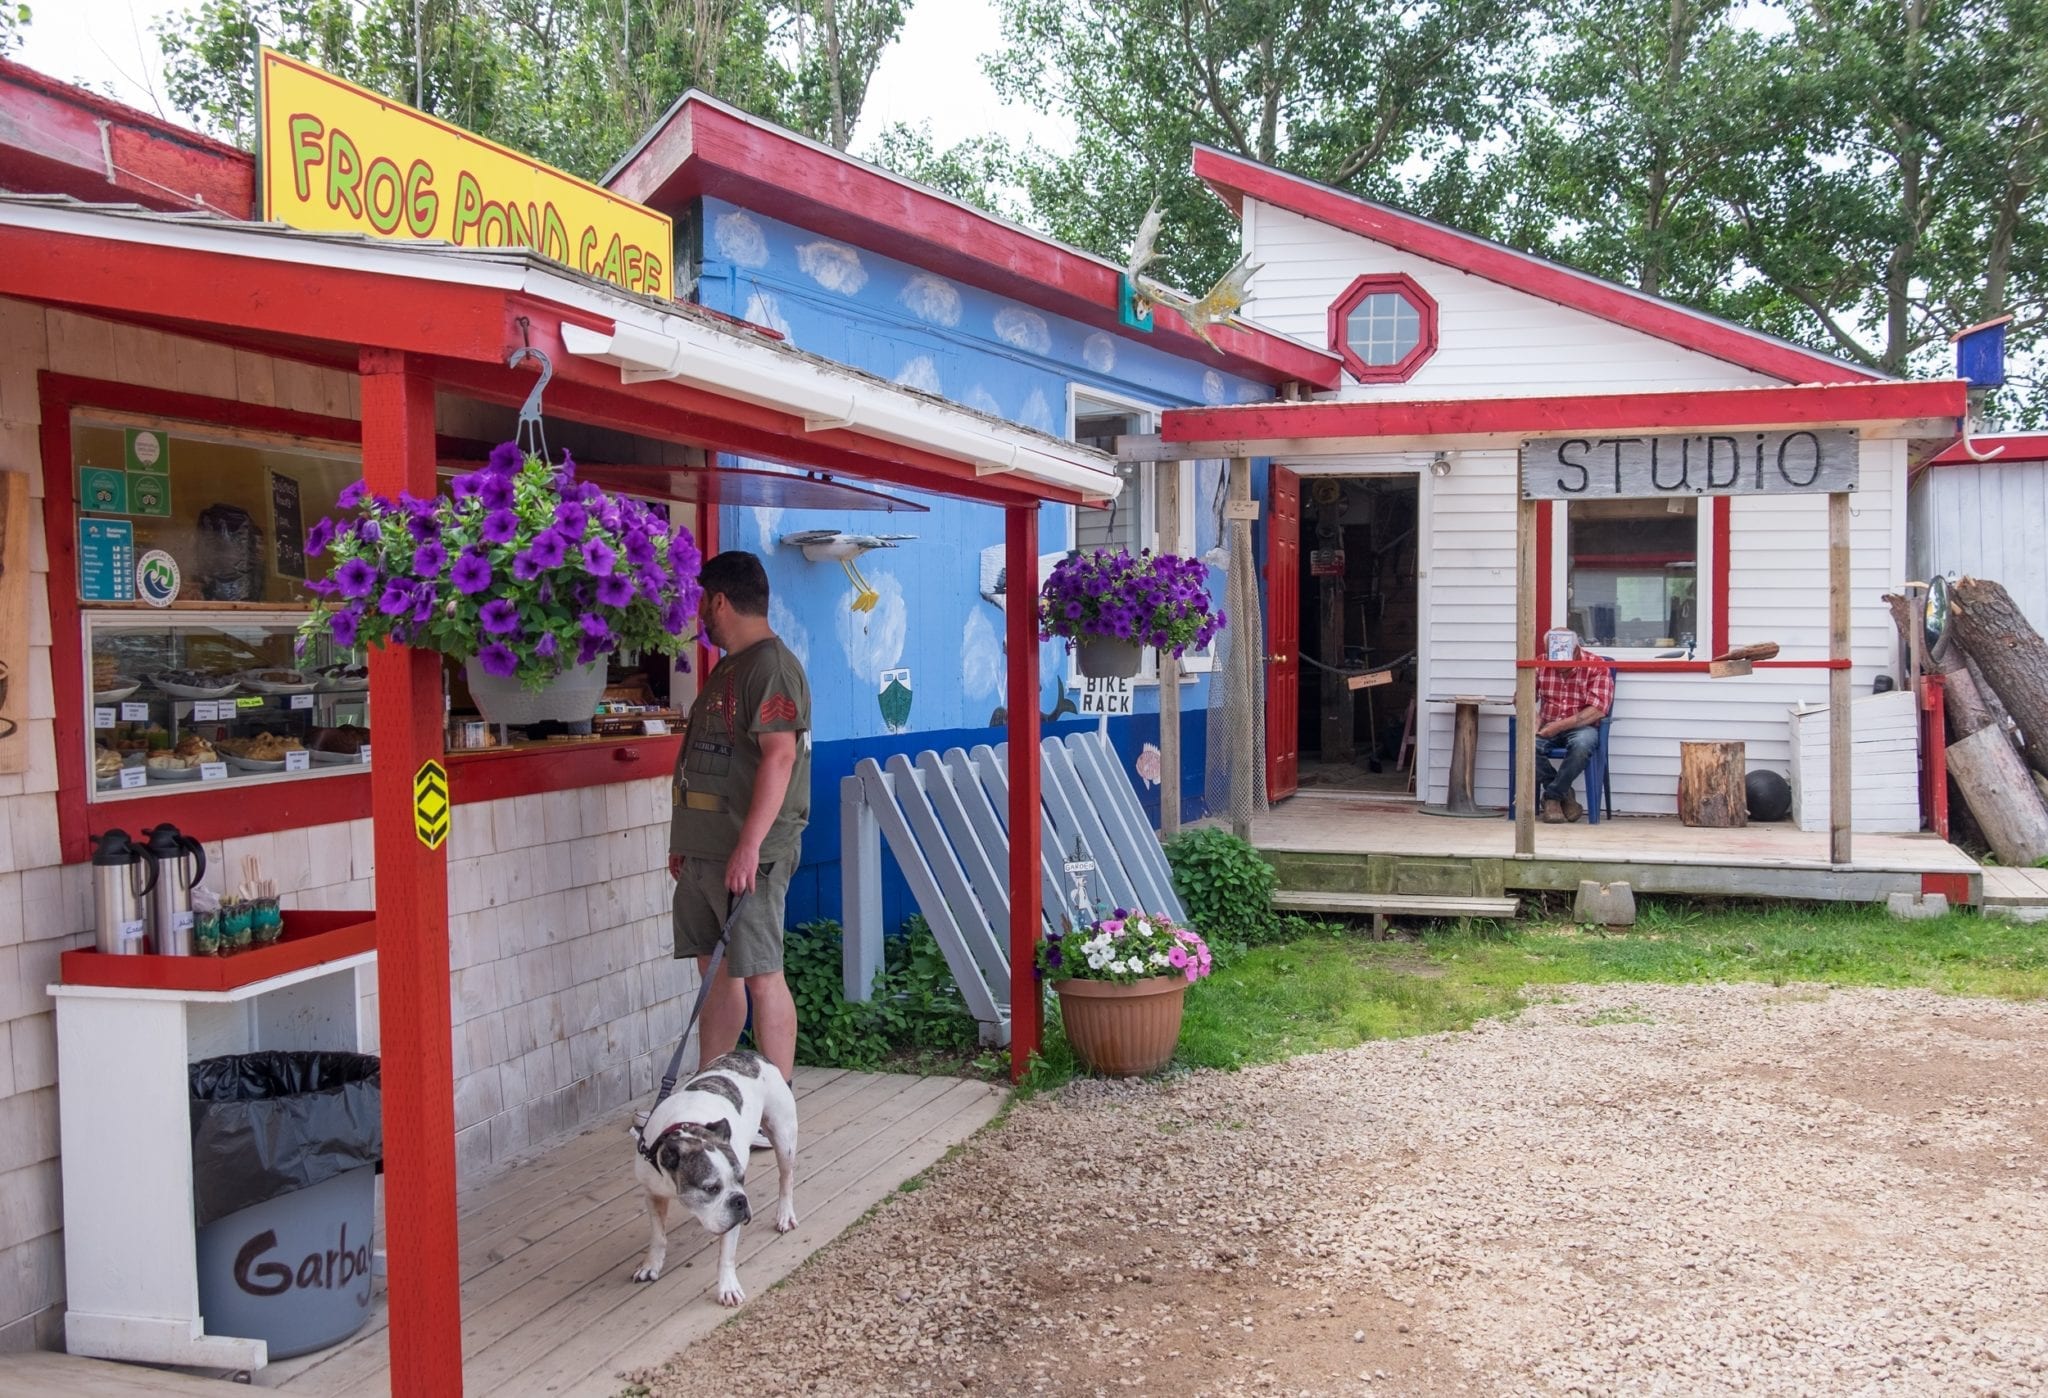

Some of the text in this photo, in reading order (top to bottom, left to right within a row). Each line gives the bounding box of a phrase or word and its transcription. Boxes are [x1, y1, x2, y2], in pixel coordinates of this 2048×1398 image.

[290, 113, 438, 238] FROG
[452, 171, 569, 265] POND
[1087, 676, 1128, 692] BIKE
[1083, 694, 1129, 712] RACK
[1065, 863, 1094, 871] GARDEN
[234, 1222, 373, 1307] Garbag
